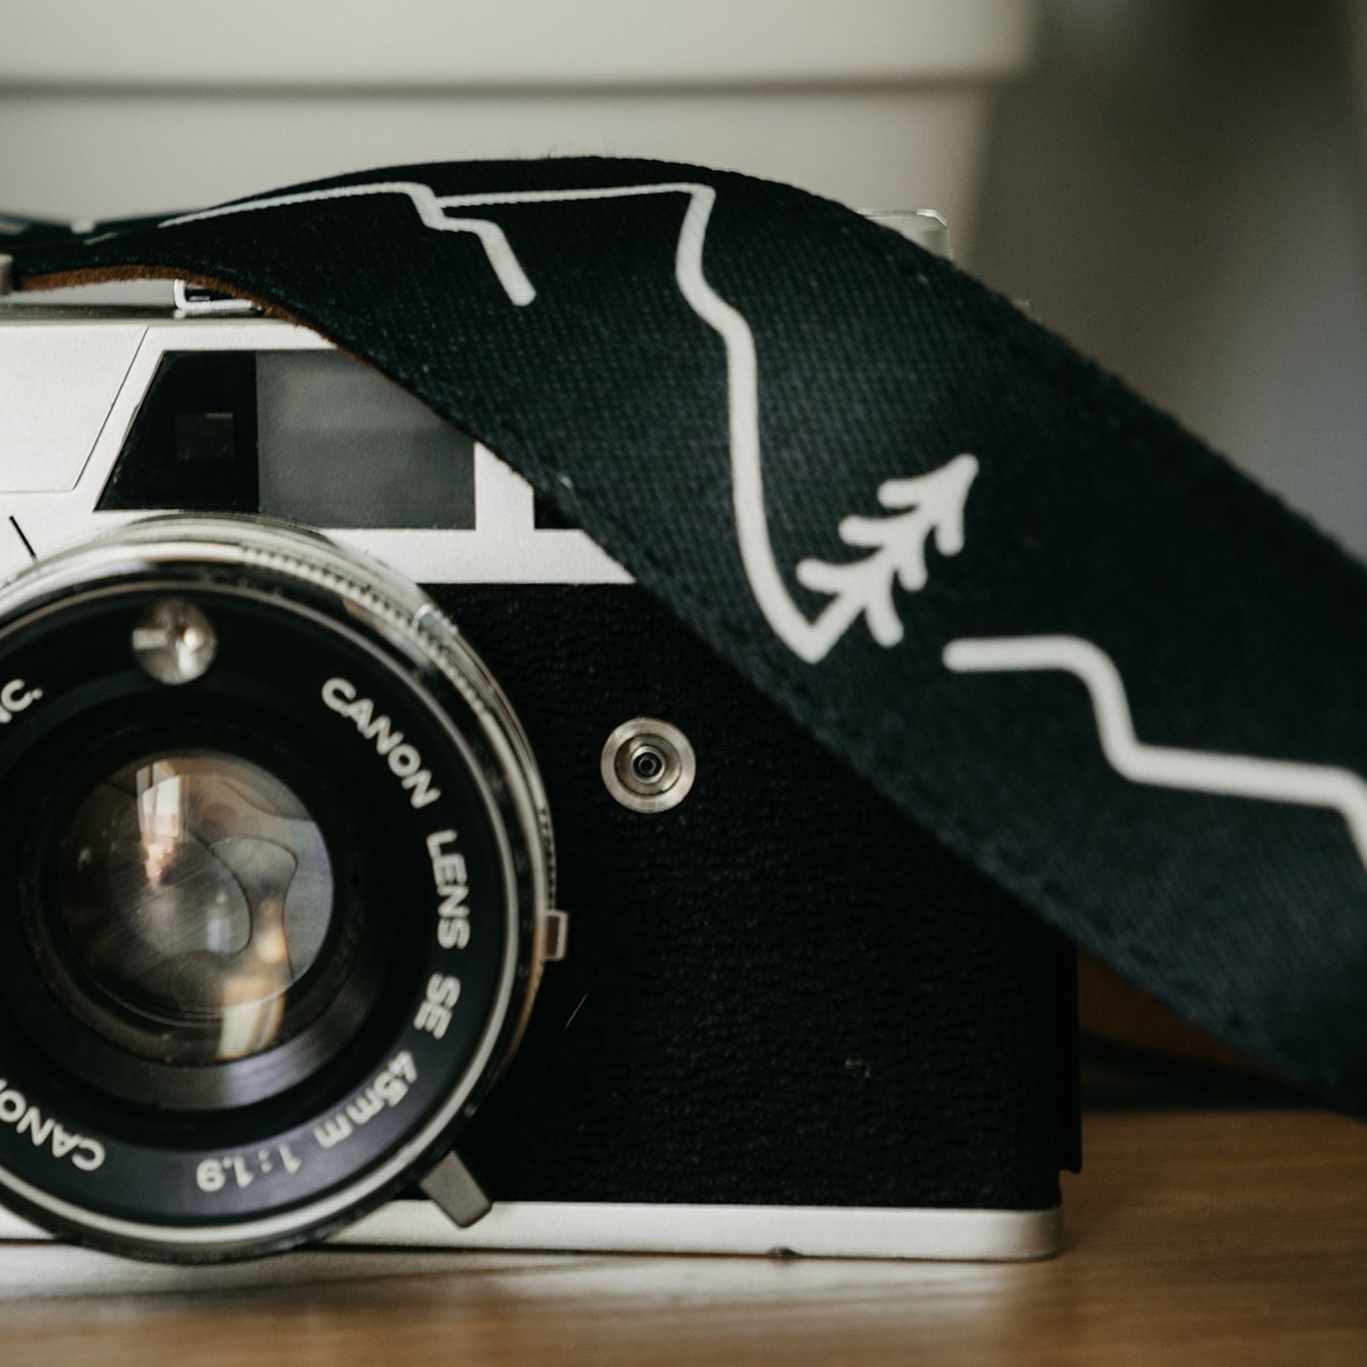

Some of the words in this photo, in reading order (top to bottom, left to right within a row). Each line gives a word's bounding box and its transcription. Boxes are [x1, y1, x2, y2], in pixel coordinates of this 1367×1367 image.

[321, 676, 441, 809] CANON
[426, 830, 470, 949] LENS
[413, 973, 461, 1039] SE
[313, 1050, 418, 1149] 45mm
